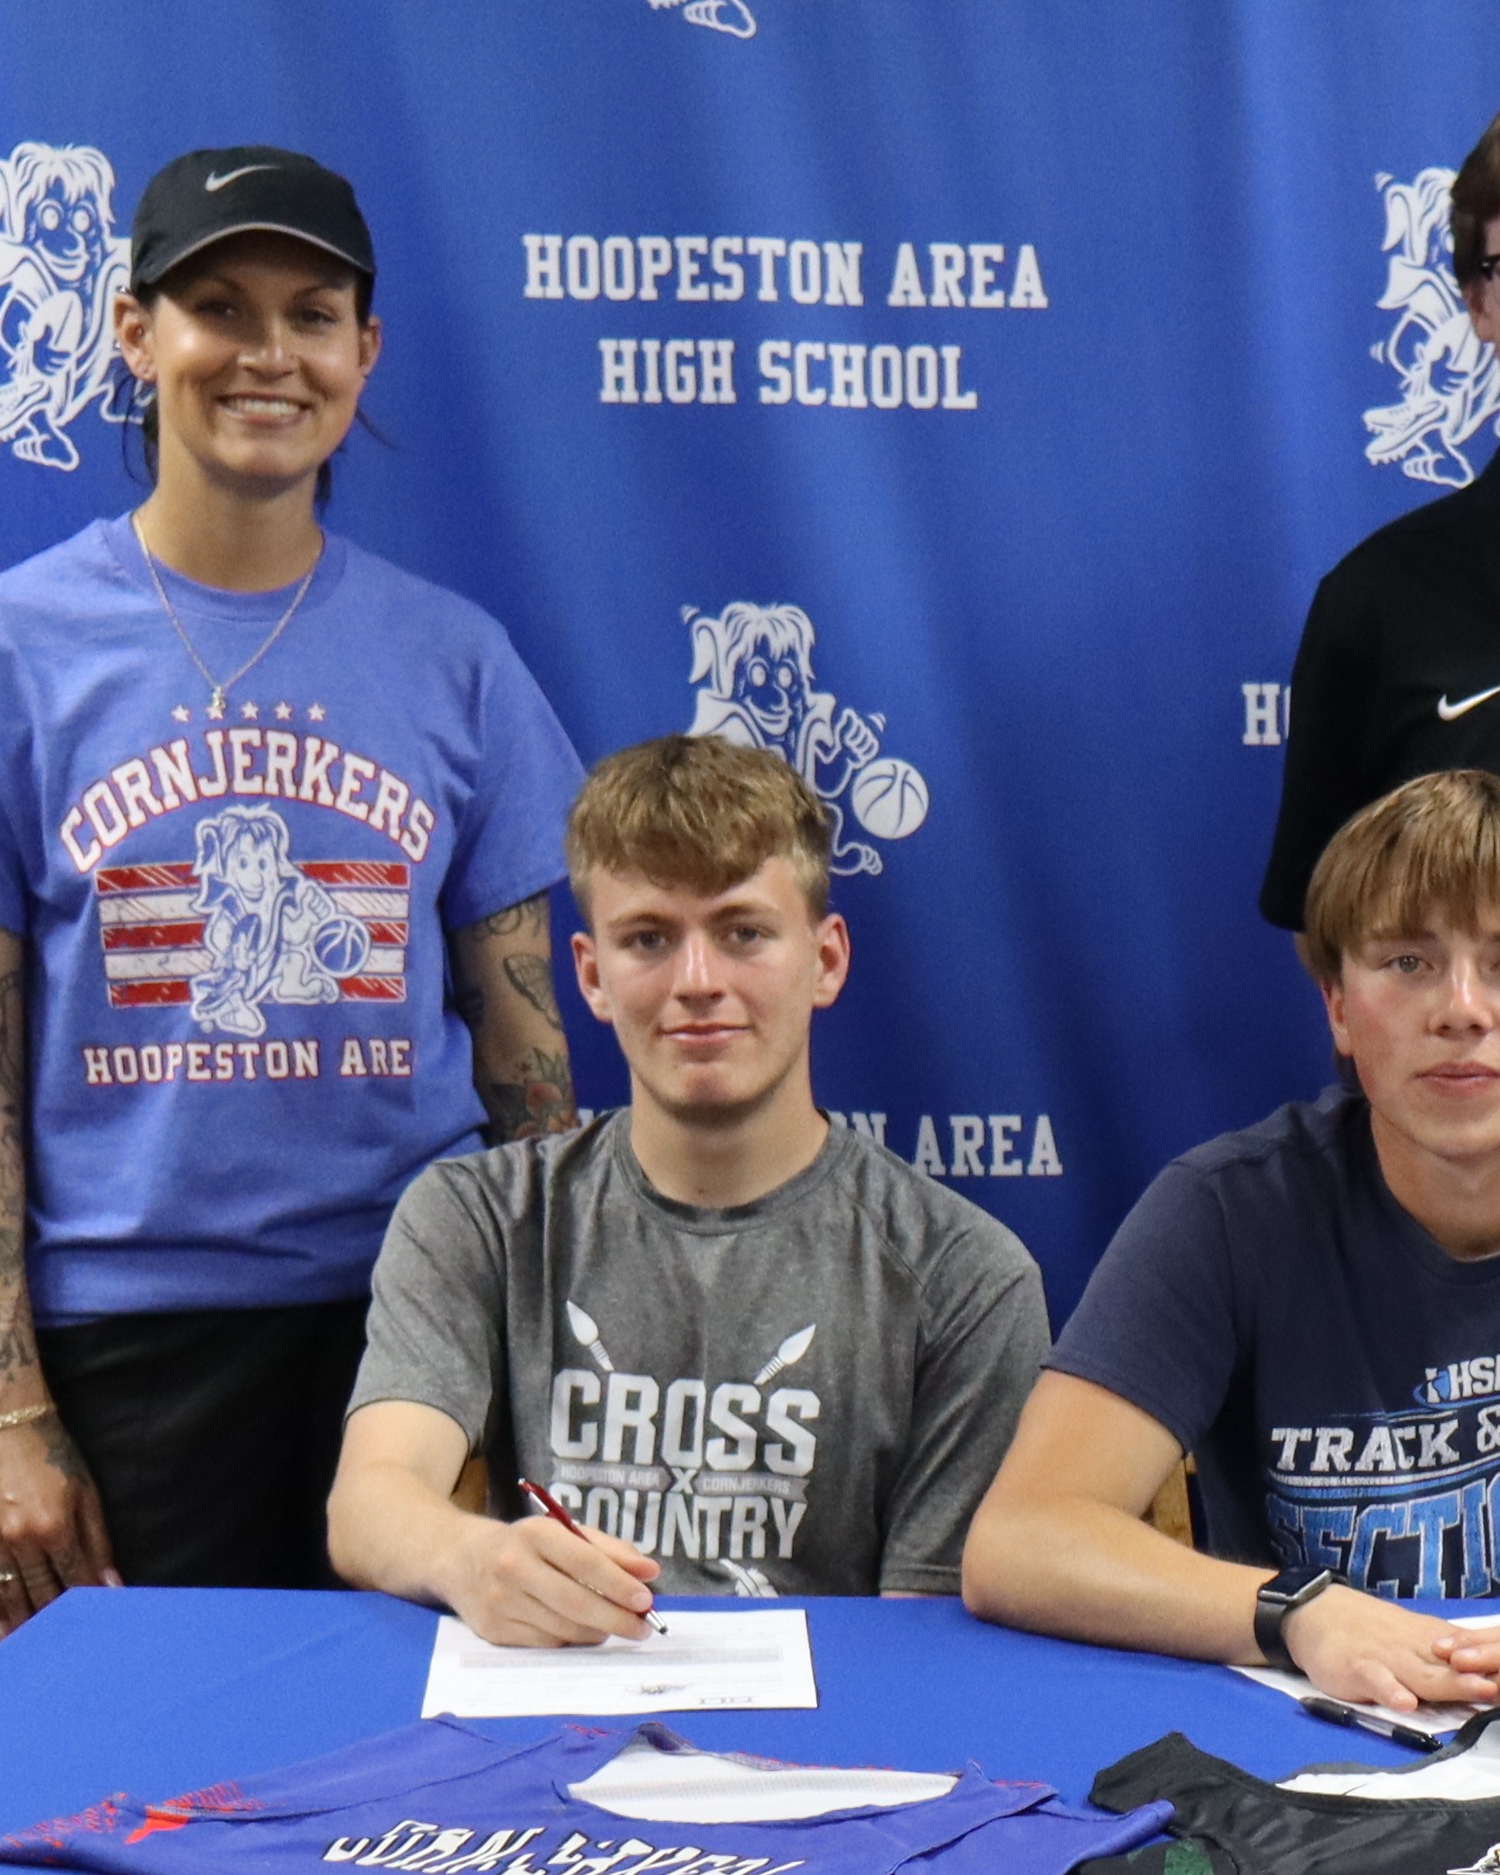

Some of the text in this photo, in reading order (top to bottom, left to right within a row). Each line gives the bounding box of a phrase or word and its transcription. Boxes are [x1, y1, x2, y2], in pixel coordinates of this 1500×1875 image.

[522, 234, 1048, 310] HOOPESTON AREA
[599, 338, 978, 410] HIGH SCHOOL
[59, 727, 436, 874] CORNJERKERS
[82, 1038, 413, 1085] HOOPESTON ARE
[913, 1113, 1064, 1177] AREA
[549, 1367, 821, 1478] CROSS
[1271, 1419, 1460, 1473] TRACK
[559, 1465, 627, 1487] HOOPESTON
[628, 1468, 660, 1487] AREA
[670, 1467, 697, 1495] X
[548, 1480, 809, 1560] COUNTRY
